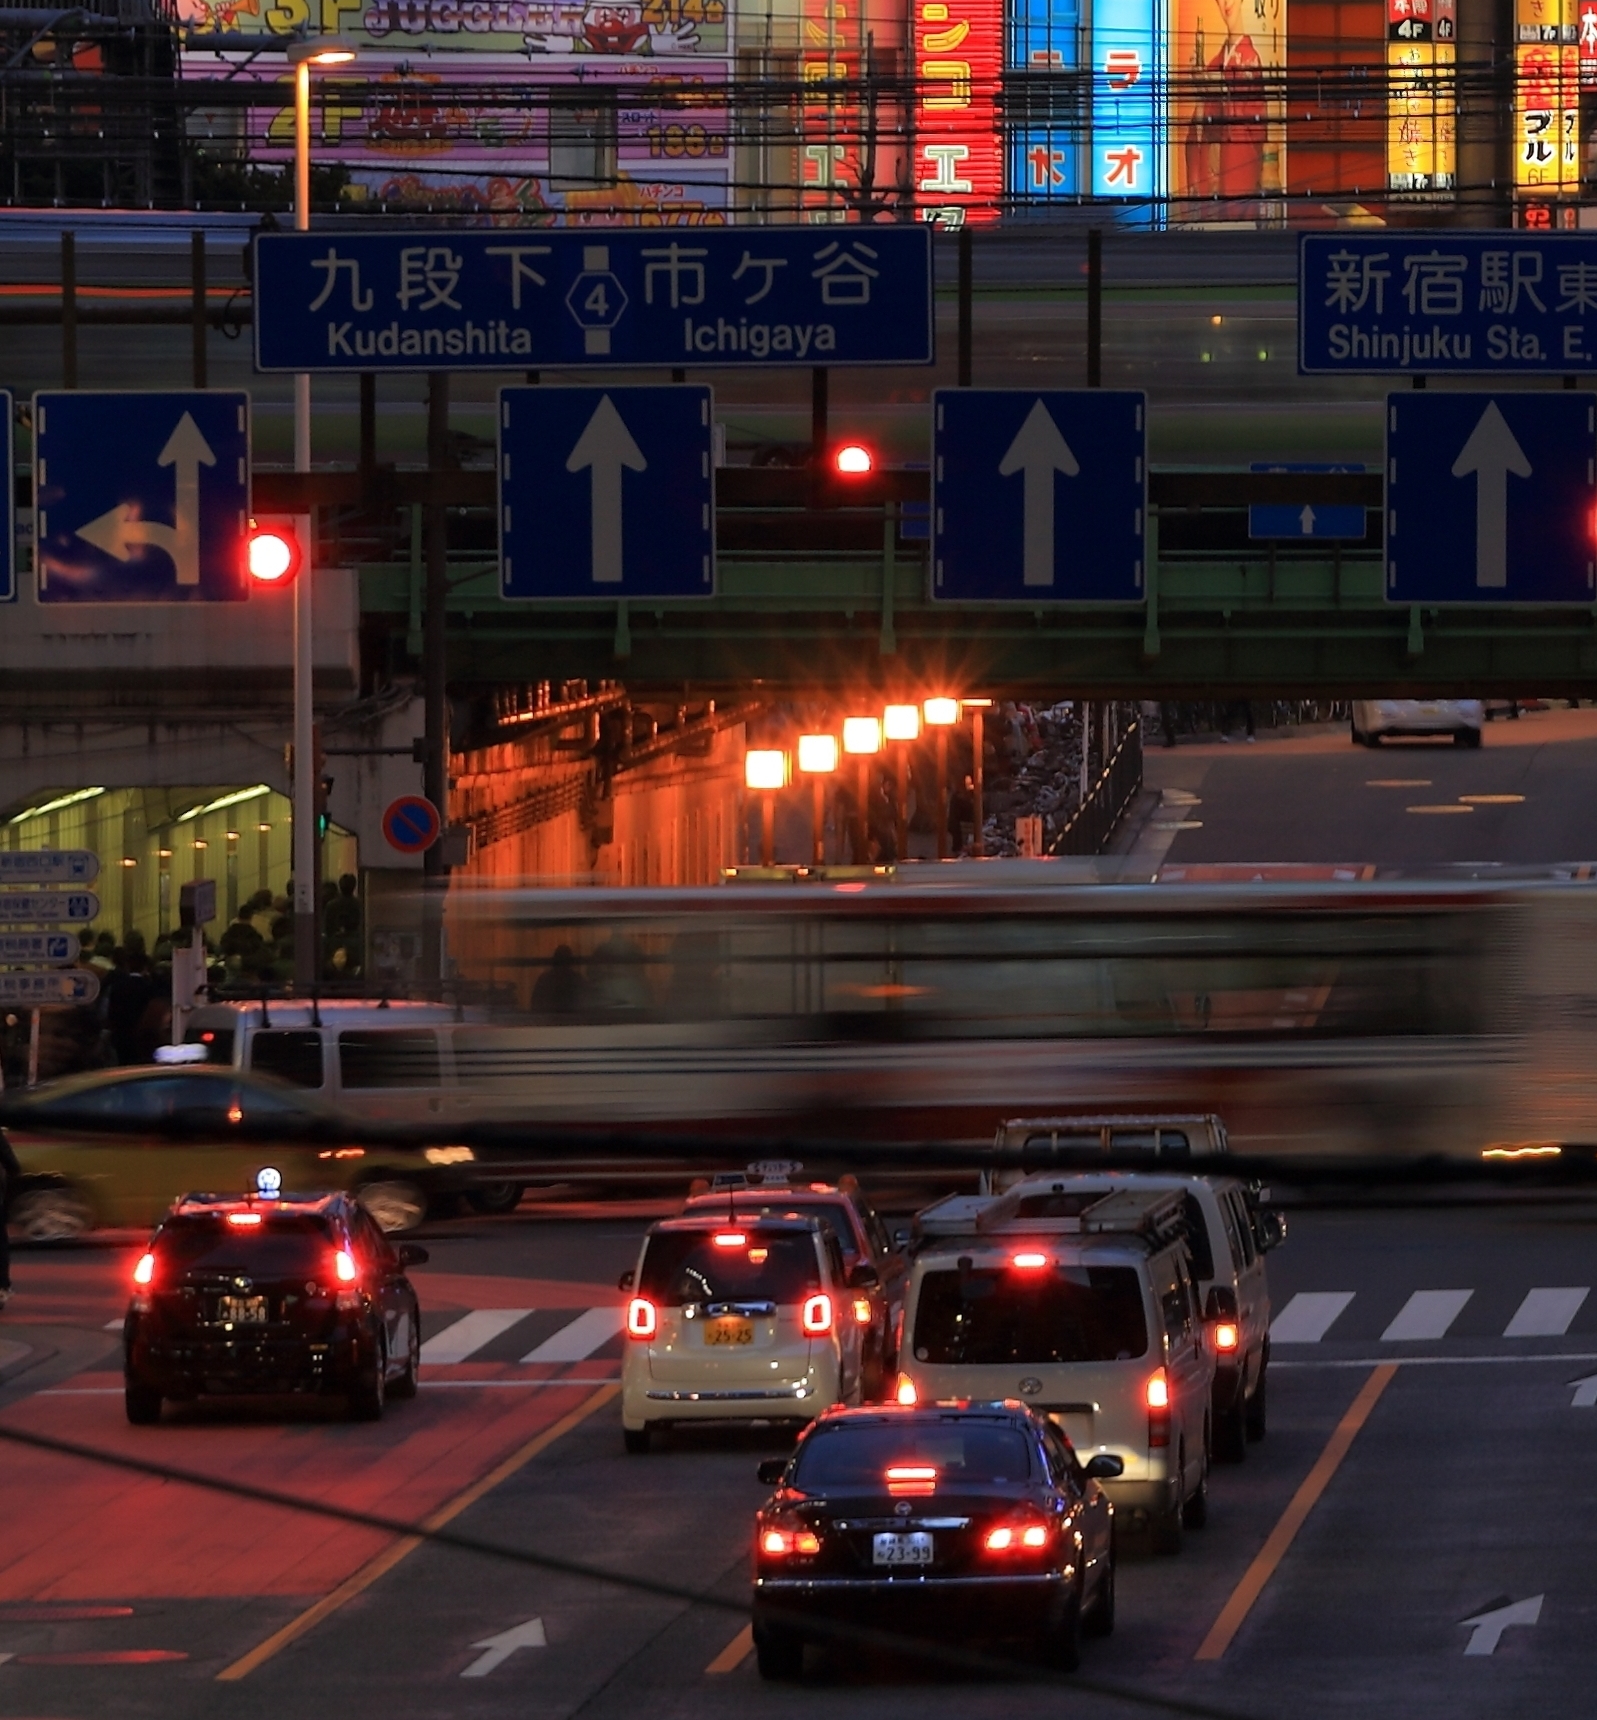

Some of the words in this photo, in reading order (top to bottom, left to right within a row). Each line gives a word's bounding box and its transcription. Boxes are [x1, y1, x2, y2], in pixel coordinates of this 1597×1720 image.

[1398, 20, 1423, 38] 4F
[310, 246, 553, 314] 九段下
[584, 283, 610, 317] 4
[328, 322, 533, 357] Kudanshita
[685, 318, 837, 358] Ichigaya
[1329, 325, 1471, 365] Shinjuku
[1486, 326, 1547, 361] Sta.
[1563, 327, 1593, 361] E.
[887, 1546, 930, 1561] 23-99
